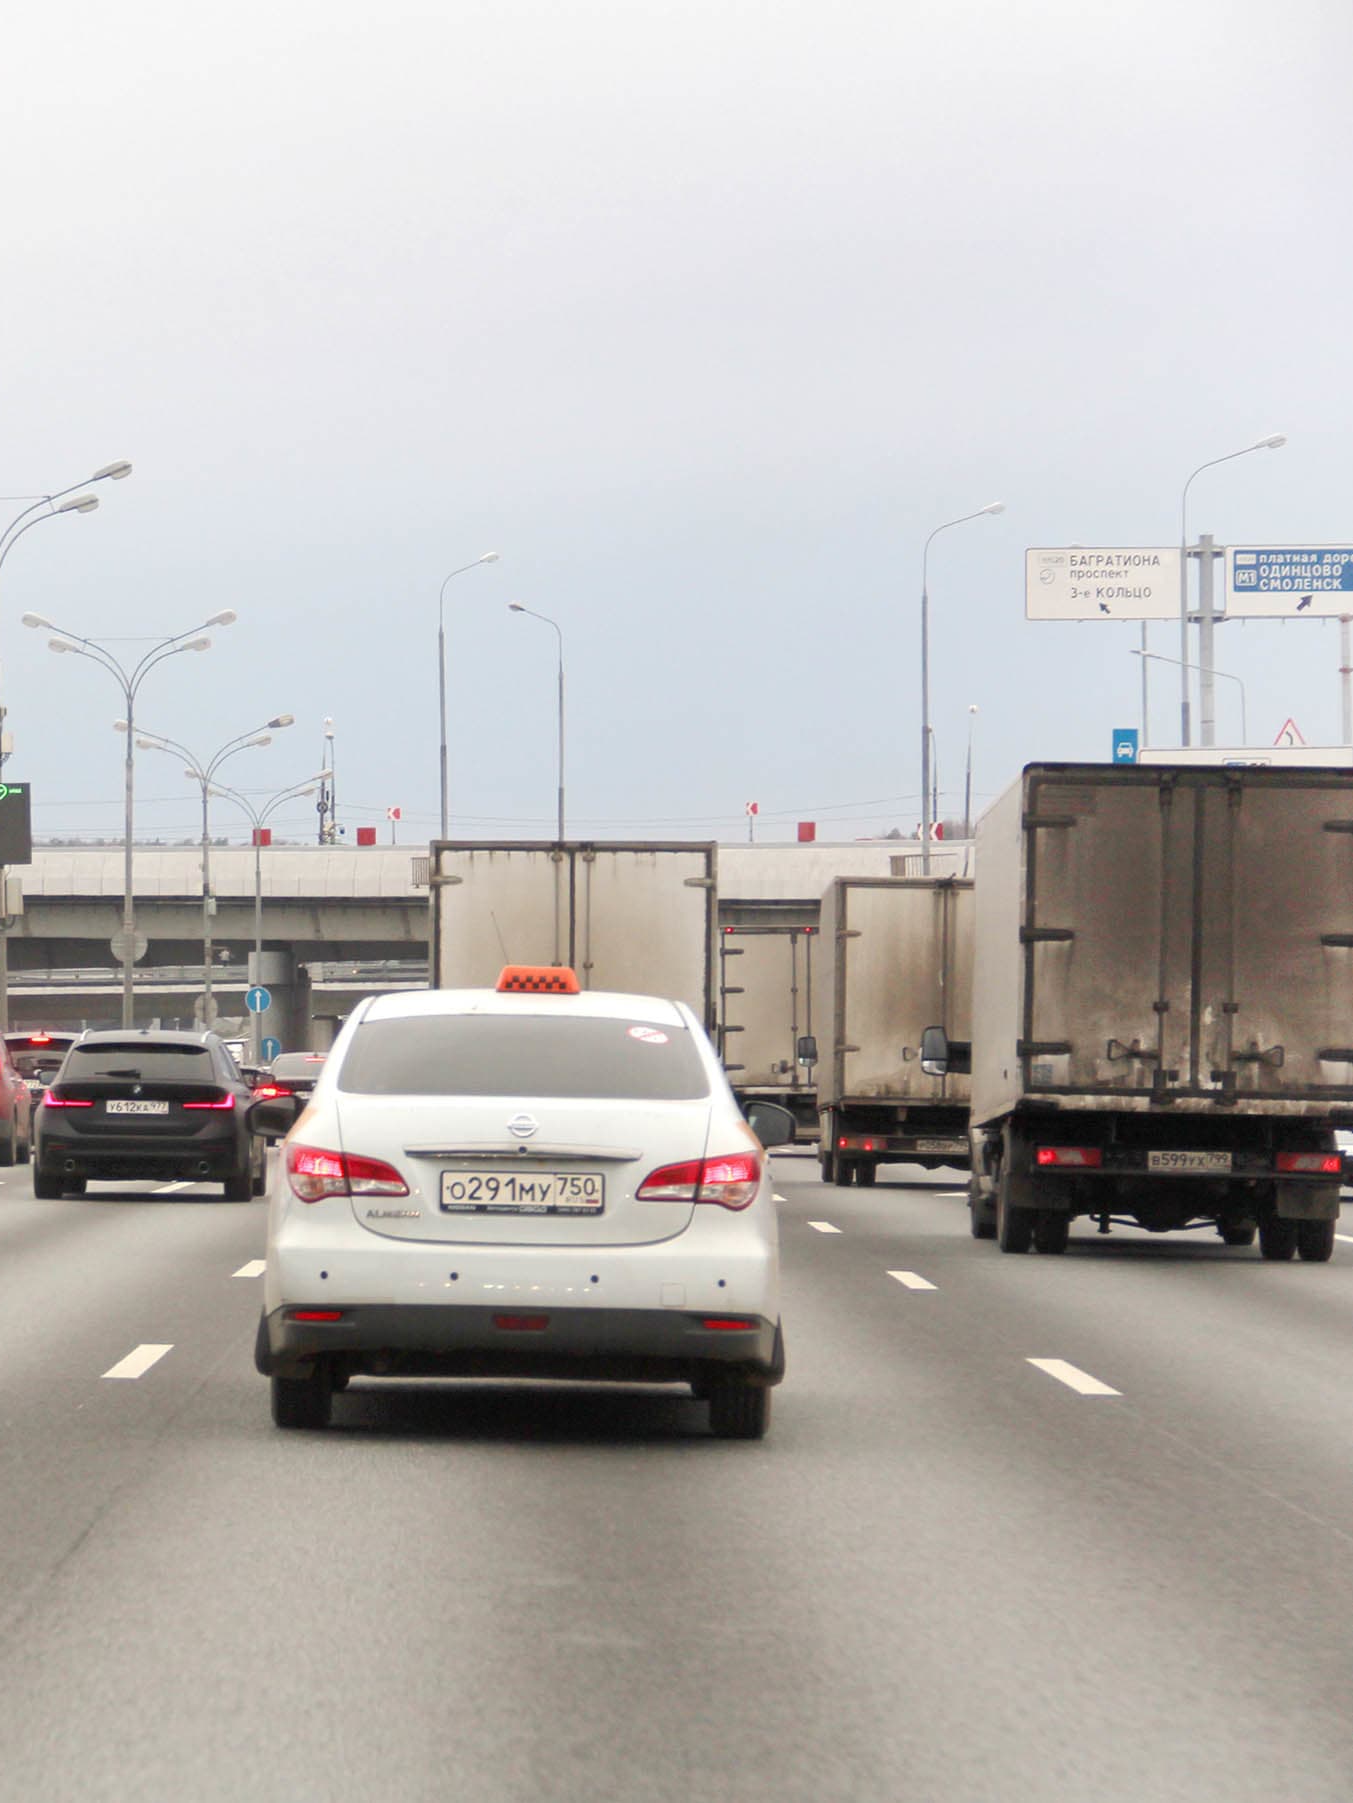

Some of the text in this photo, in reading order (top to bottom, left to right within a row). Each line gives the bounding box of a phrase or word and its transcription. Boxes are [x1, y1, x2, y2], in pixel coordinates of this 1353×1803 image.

[1069, 555, 1161, 566] БАГРАТИОНА
[1259, 553, 1317, 563] платная
[1069, 569, 1129, 581] проспект
[1259, 565, 1342, 578] ОДИНЦОВО
[1259, 578, 1342, 590] СМОЛЕНСК
[1096, 587, 1152, 600] КОЛЬЦО
[557, 1177, 596, 1196] 750
